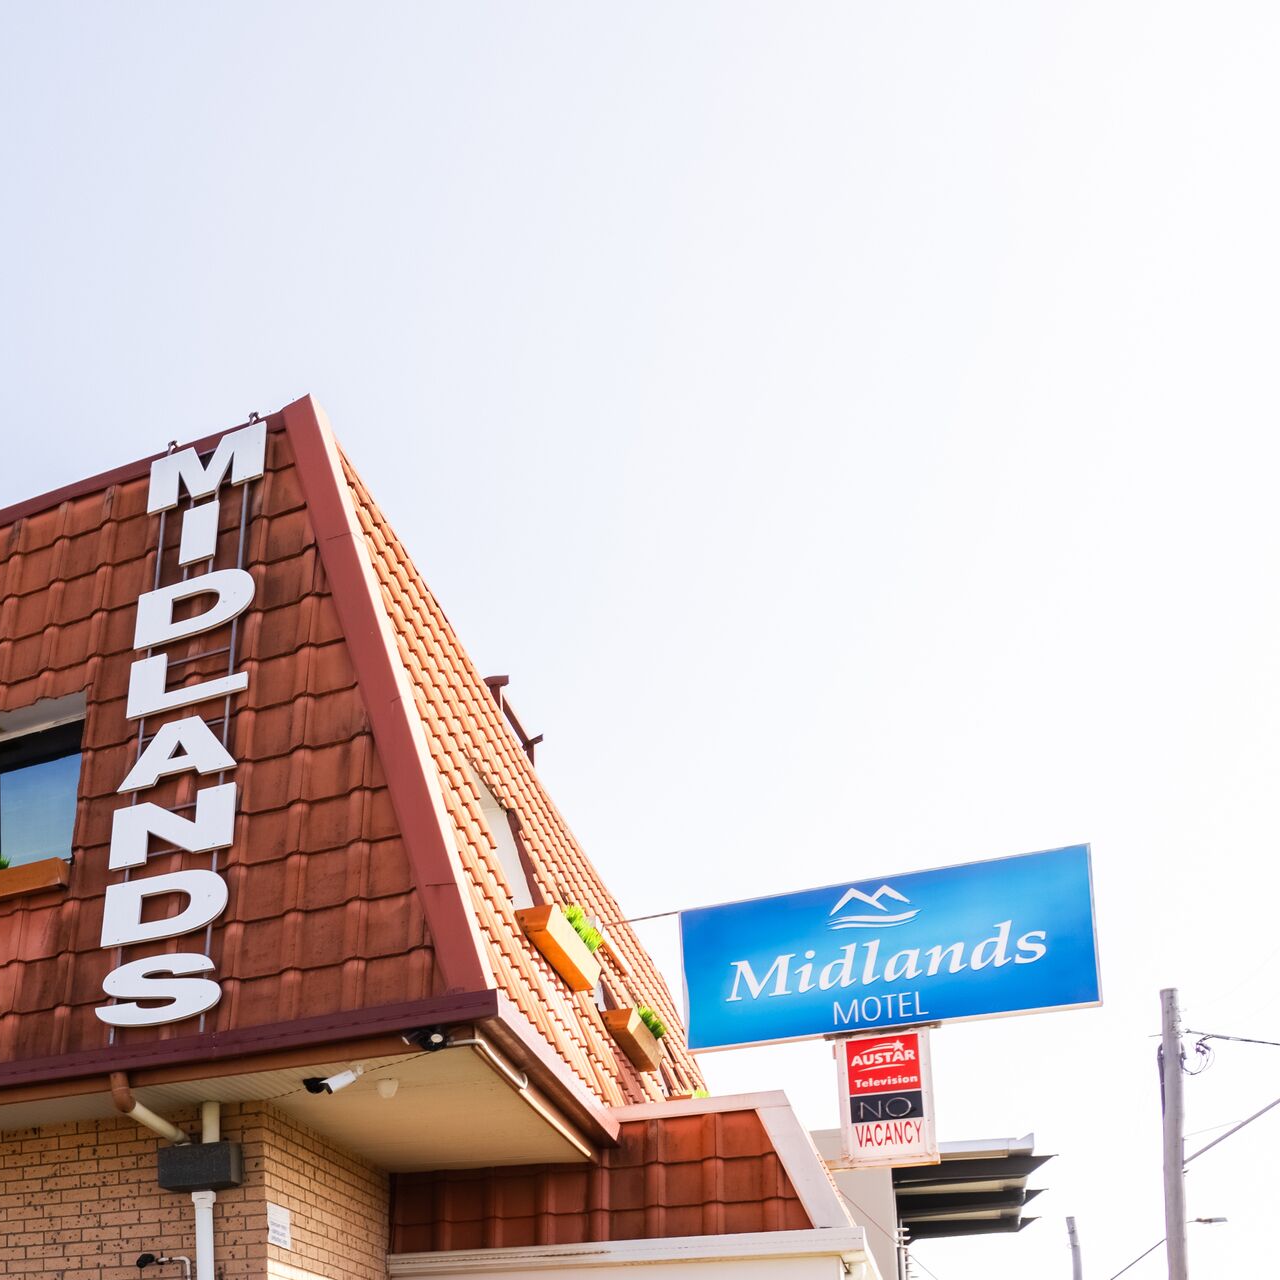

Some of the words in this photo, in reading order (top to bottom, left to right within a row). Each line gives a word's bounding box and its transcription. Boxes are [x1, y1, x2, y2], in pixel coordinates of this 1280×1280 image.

[95, 421, 267, 1027] MIDLANDS
[725, 920, 1047, 1002] Midlands
[833, 991, 928, 1026] MOTEL
[851, 1049, 915, 1067] AUSTAR
[854, 1075, 918, 1089] Television
[859, 1097, 911, 1119] NO
[855, 1120, 924, 1148] VACANCY
